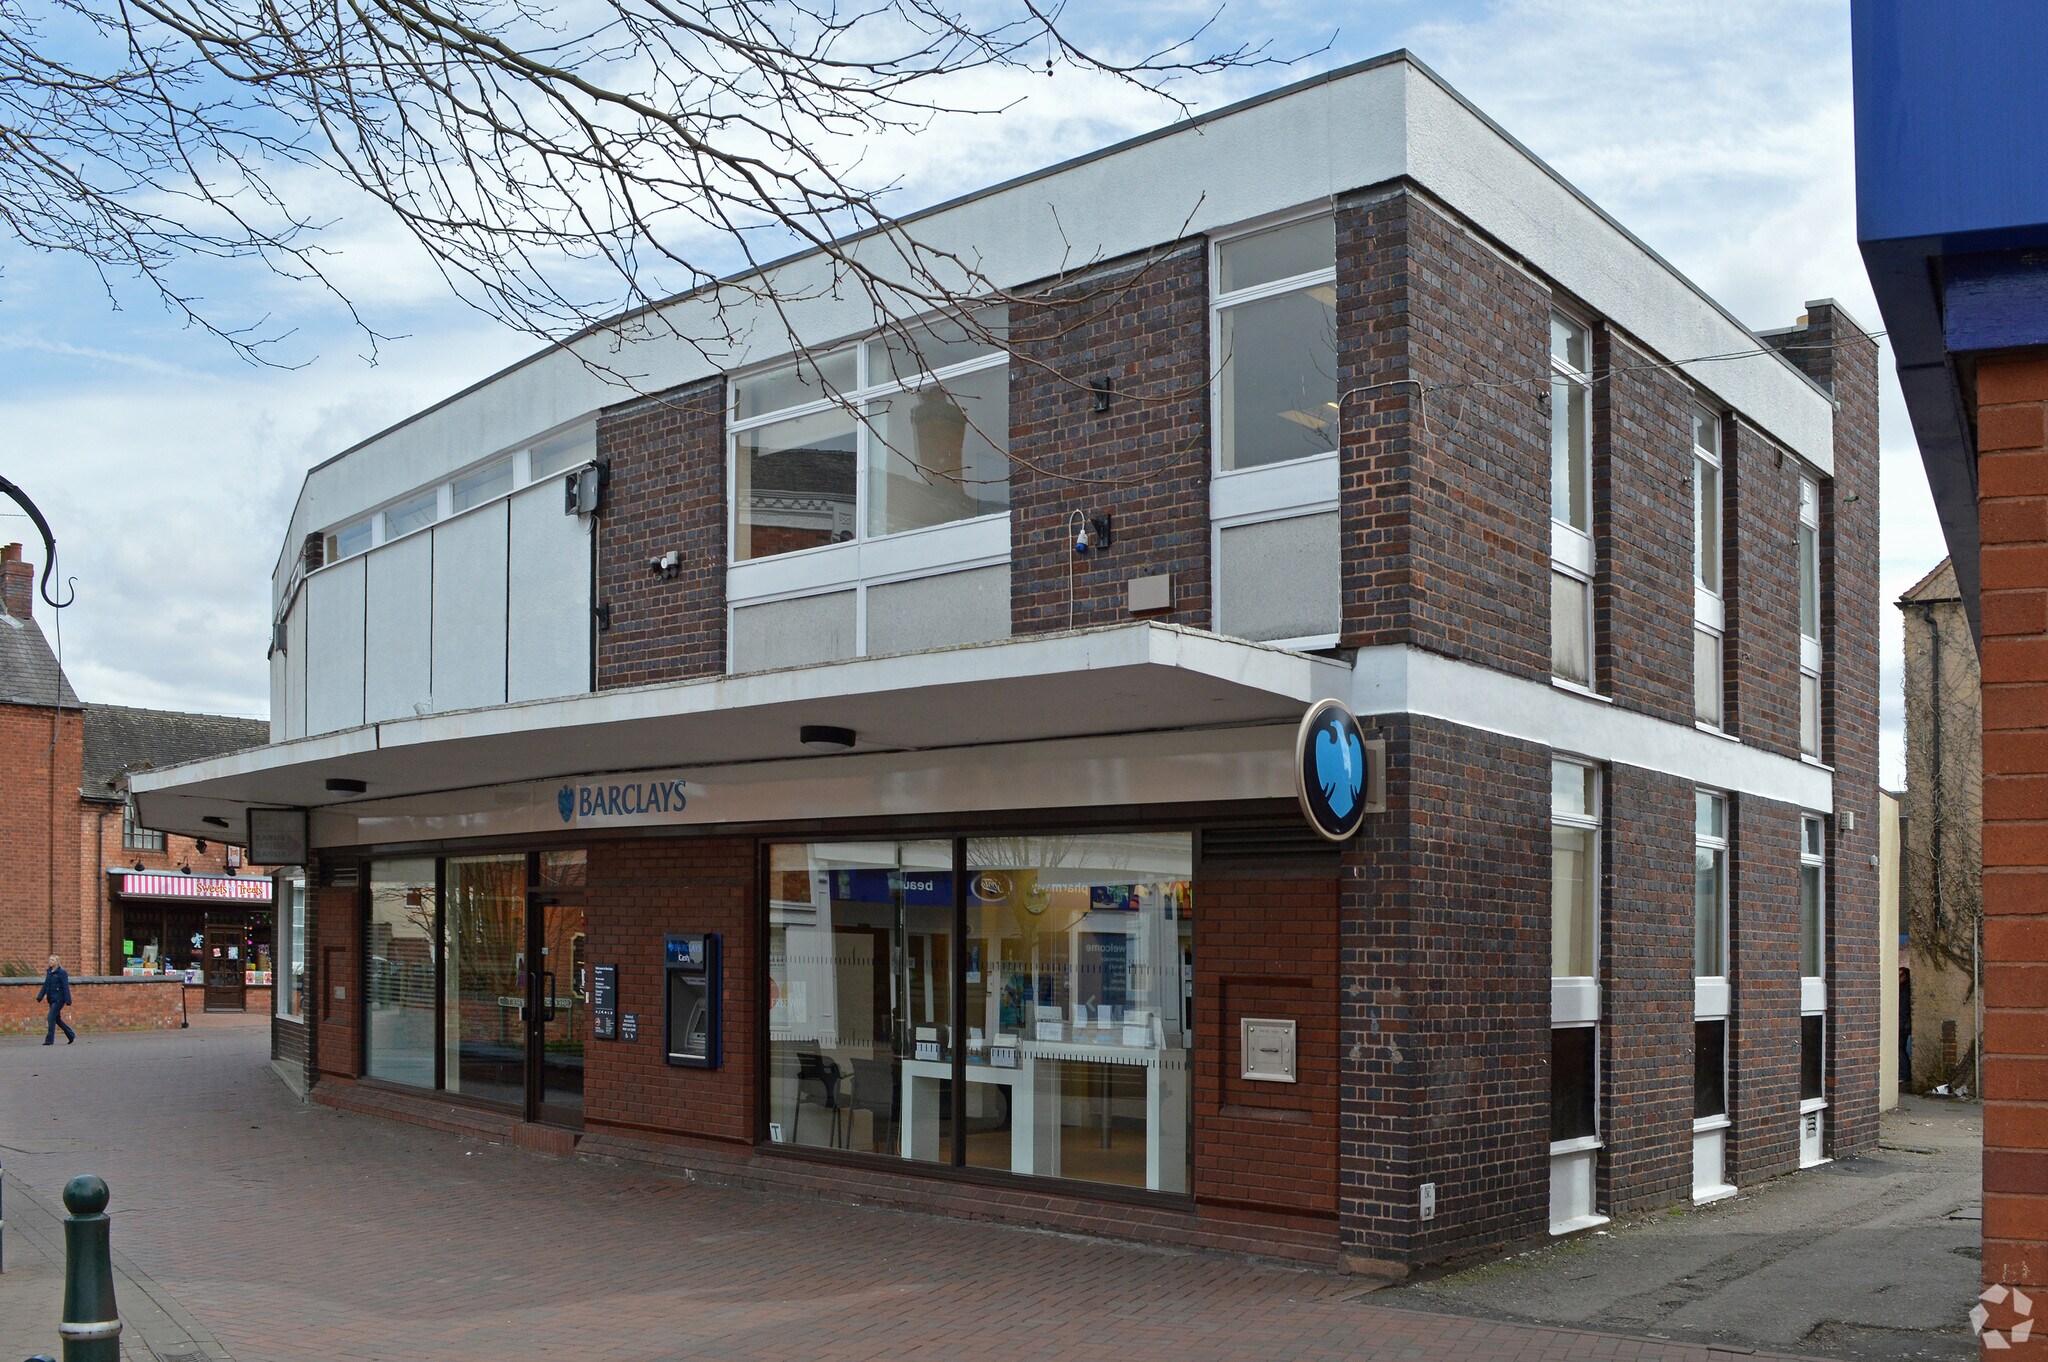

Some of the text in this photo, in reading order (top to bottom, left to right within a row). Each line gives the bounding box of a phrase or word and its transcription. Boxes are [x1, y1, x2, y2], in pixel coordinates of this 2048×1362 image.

[579, 780, 687, 817] BARCLAYS
[196, 882, 228, 895] Sweets
[238, 884, 263, 896] Treats
[678, 954, 690, 964] Cash
